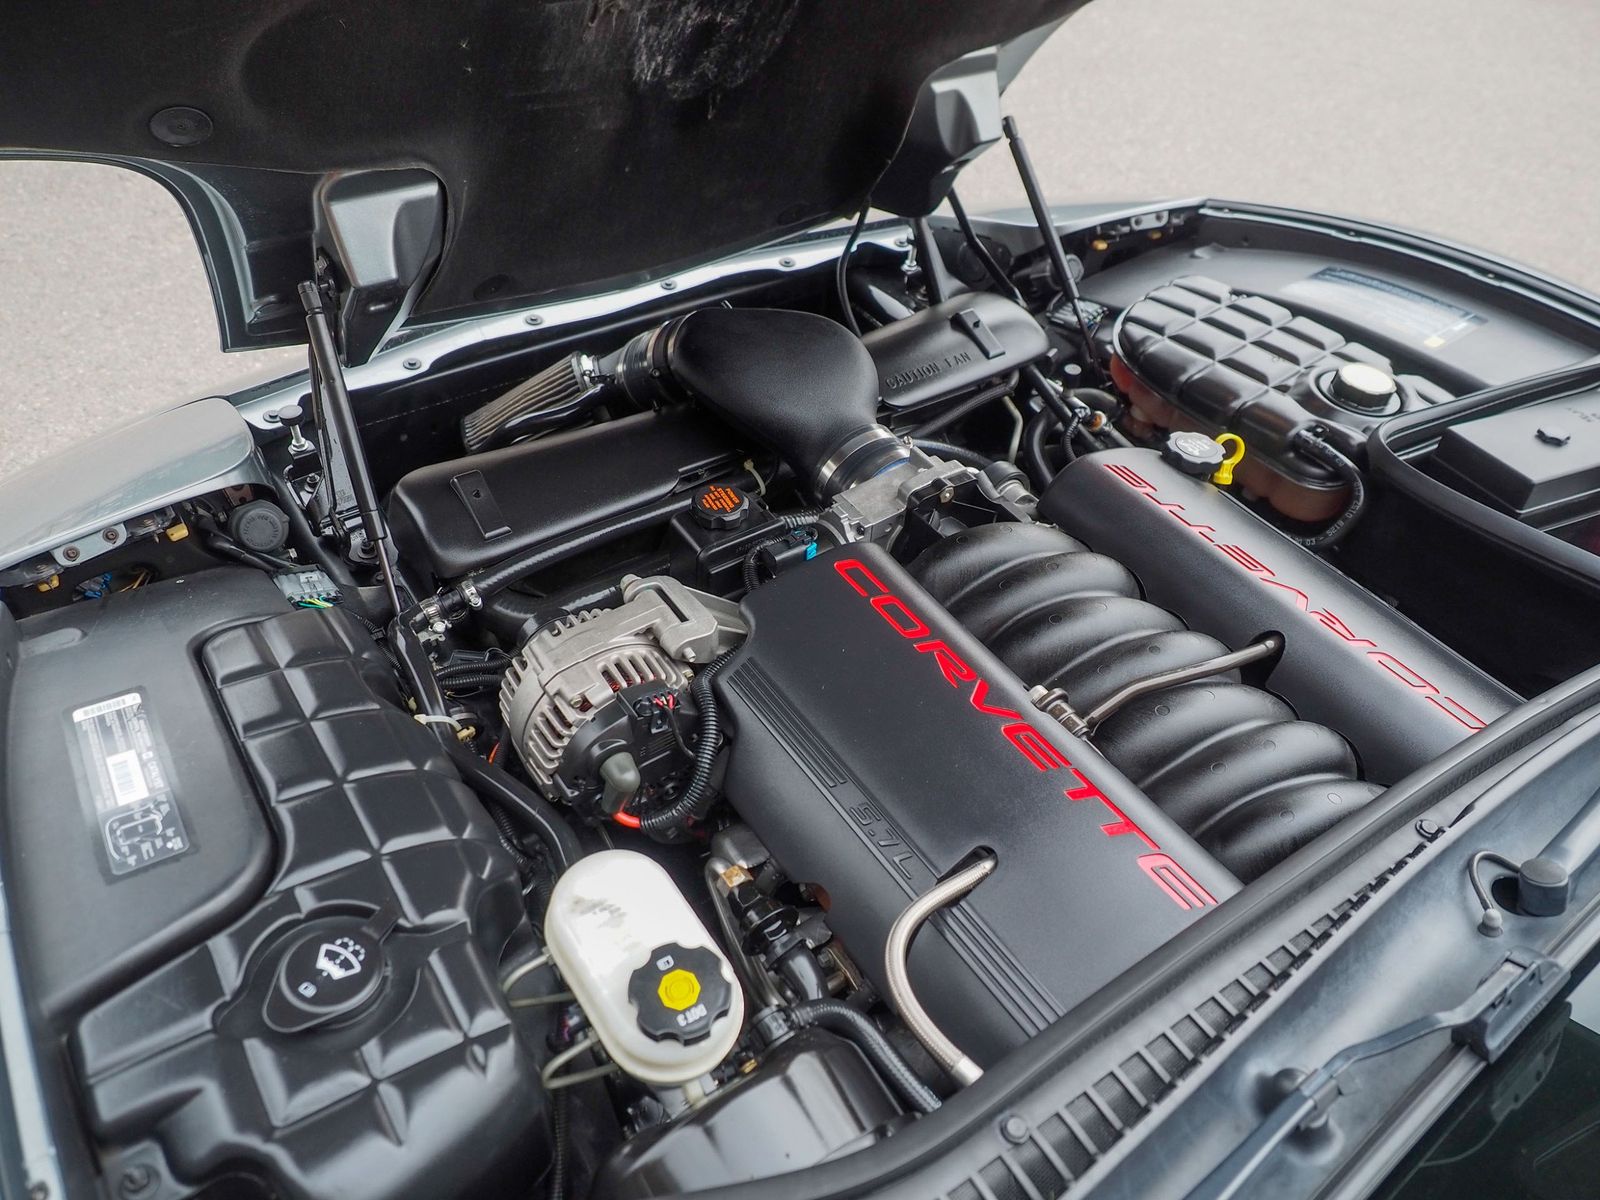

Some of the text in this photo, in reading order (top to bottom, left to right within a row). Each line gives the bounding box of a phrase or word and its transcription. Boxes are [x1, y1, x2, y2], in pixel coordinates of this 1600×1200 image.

[886, 362, 940, 390] CAUTION
[1103, 463, 1489, 735] CORVETTE
[834, 559, 1219, 911] CORVETTE
[849, 801, 913, 880] 5.7L
